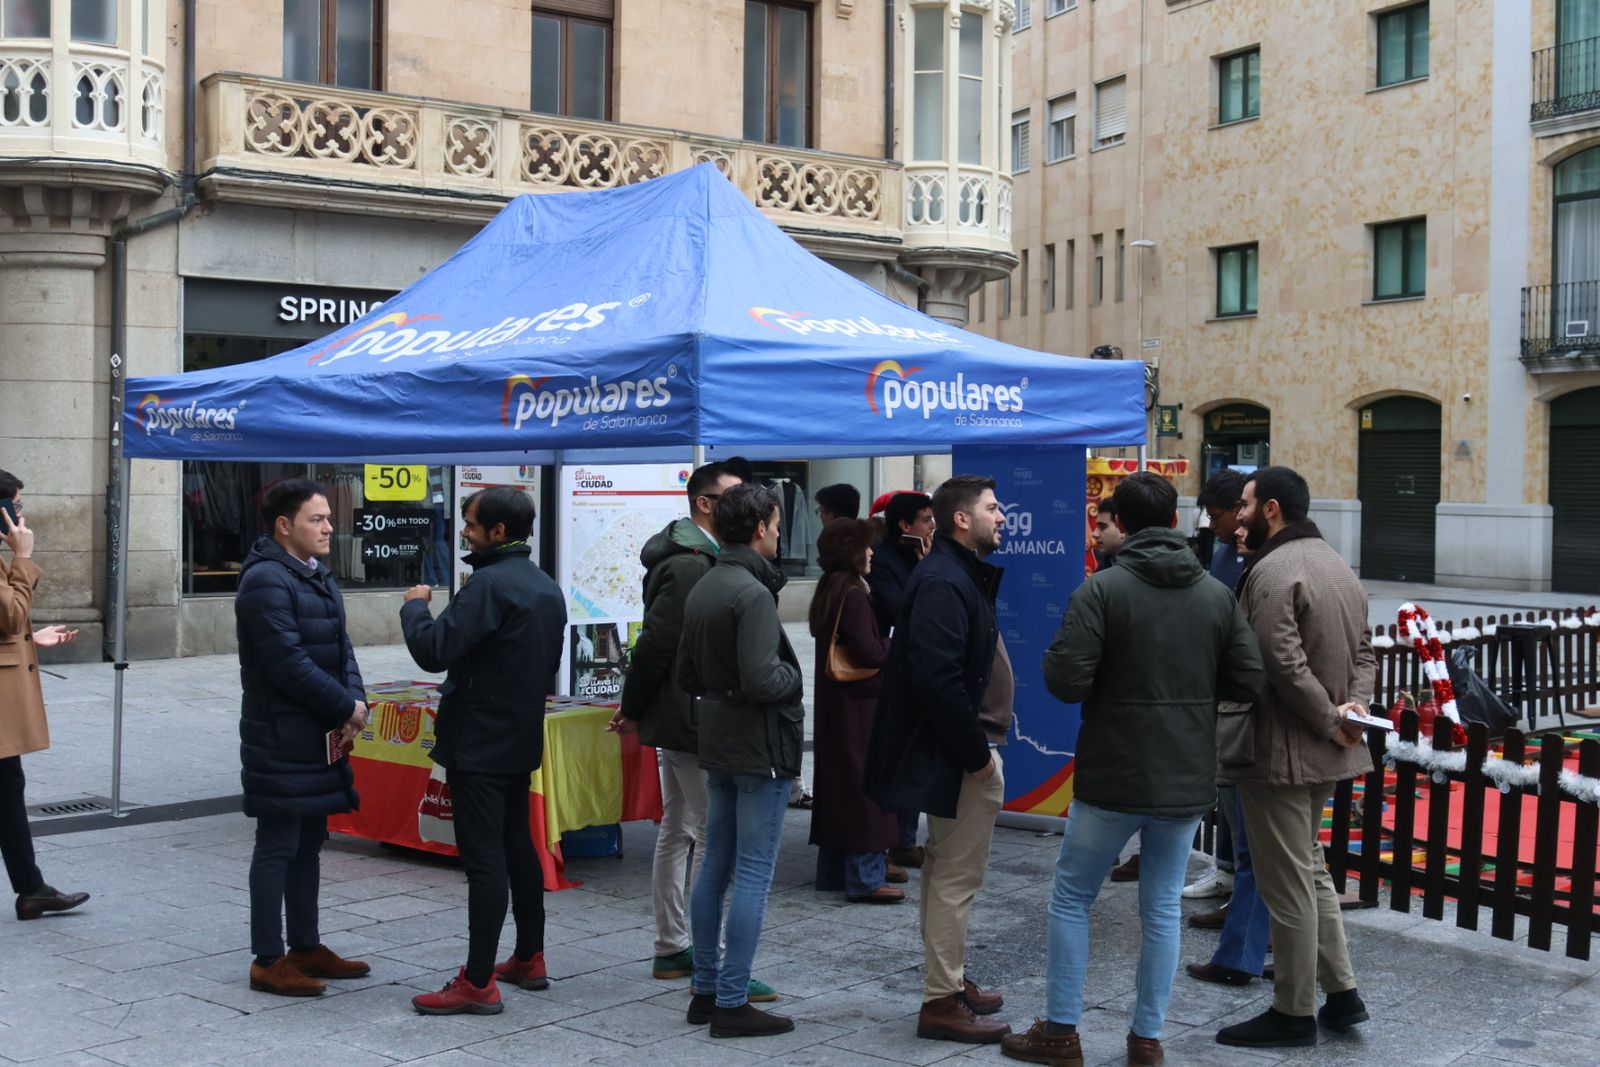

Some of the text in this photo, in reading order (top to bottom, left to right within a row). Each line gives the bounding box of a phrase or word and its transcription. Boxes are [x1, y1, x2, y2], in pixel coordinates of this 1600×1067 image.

[318, 302, 622, 366] populares
[514, 375, 672, 430] populares
[884, 373, 1024, 419] populares
[146, 400, 238, 436] populares
[583, 414, 667, 430] de Salamanca
[954, 413, 1023, 428] de Salamanca
[371, 467, 422, 489] -50%
[580, 480, 613, 488] CIUDAD
[356, 515, 397, 531] -30%
[365, 544, 399, 558] +10%
[993, 540, 1066, 555] LAMANCA
[585, 684, 620, 695] CIUDAD
